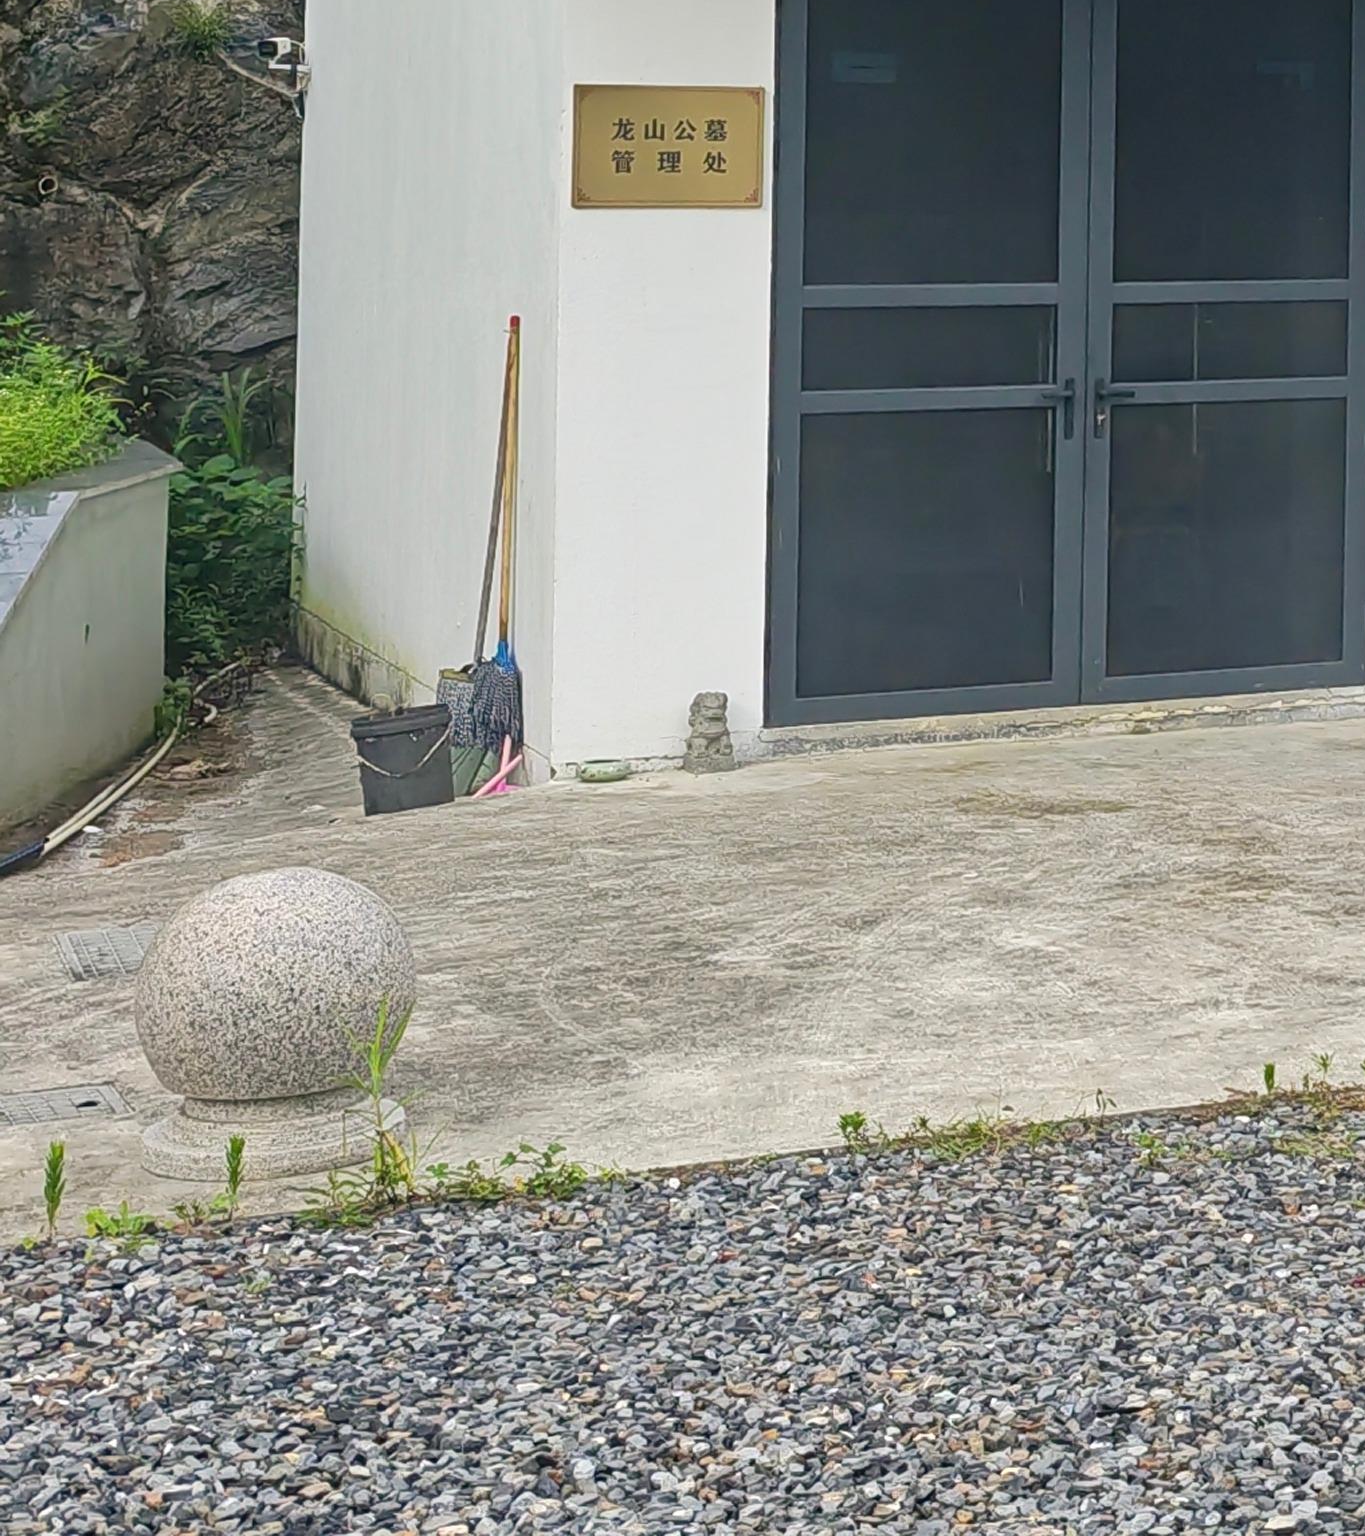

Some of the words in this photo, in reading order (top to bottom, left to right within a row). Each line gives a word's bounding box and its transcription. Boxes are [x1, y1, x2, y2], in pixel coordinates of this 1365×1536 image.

[611, 118, 728, 142] 龙山公墓
[611, 150, 728, 174] 管理处
